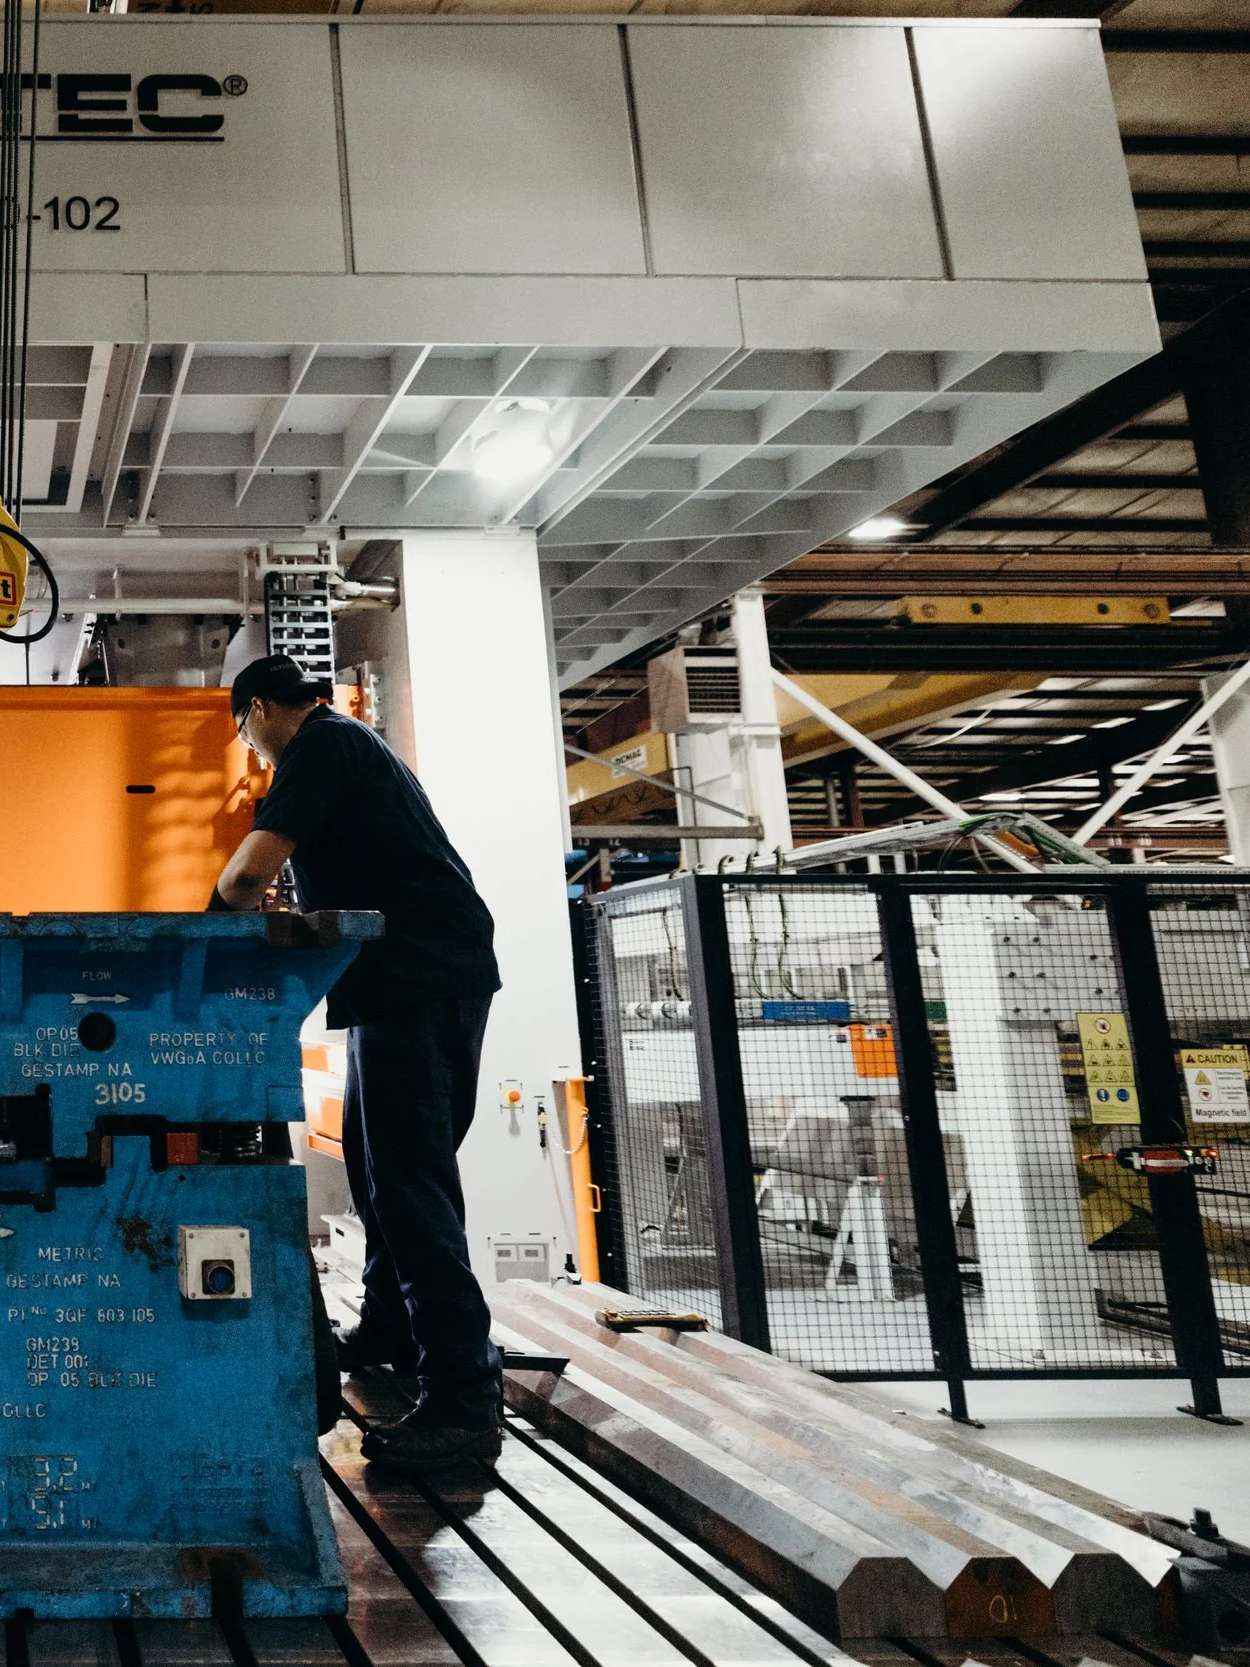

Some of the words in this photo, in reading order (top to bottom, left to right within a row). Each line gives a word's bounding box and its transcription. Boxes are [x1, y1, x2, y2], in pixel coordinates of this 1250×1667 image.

[82, 971, 112, 981] FLOW
[224, 987, 276, 1001] GM238
[149, 1032, 237, 1047] PROPERTY
[248, 1032, 268, 1046] OF
[14, 1043, 43, 1057] BLK
[51, 1043, 80, 1057] DIE
[1197, 1055, 1238, 1064] CAUTION
[21, 1063, 99, 1078] GESTAMP
[107, 1063, 133, 1077] NA
[95, 1082, 146, 1105] 3105
[1195, 1108, 1229, 1118] Magnetic
[1231, 1108, 1247, 1116] field
[38, 1247, 103, 1262] METRIC
[6, 1274, 88, 1288] GESTAMP
[98, 1274, 121, 1288] NA
[132, 1309, 155, 1322] 105
[60, 1372, 80, 1388] 05
